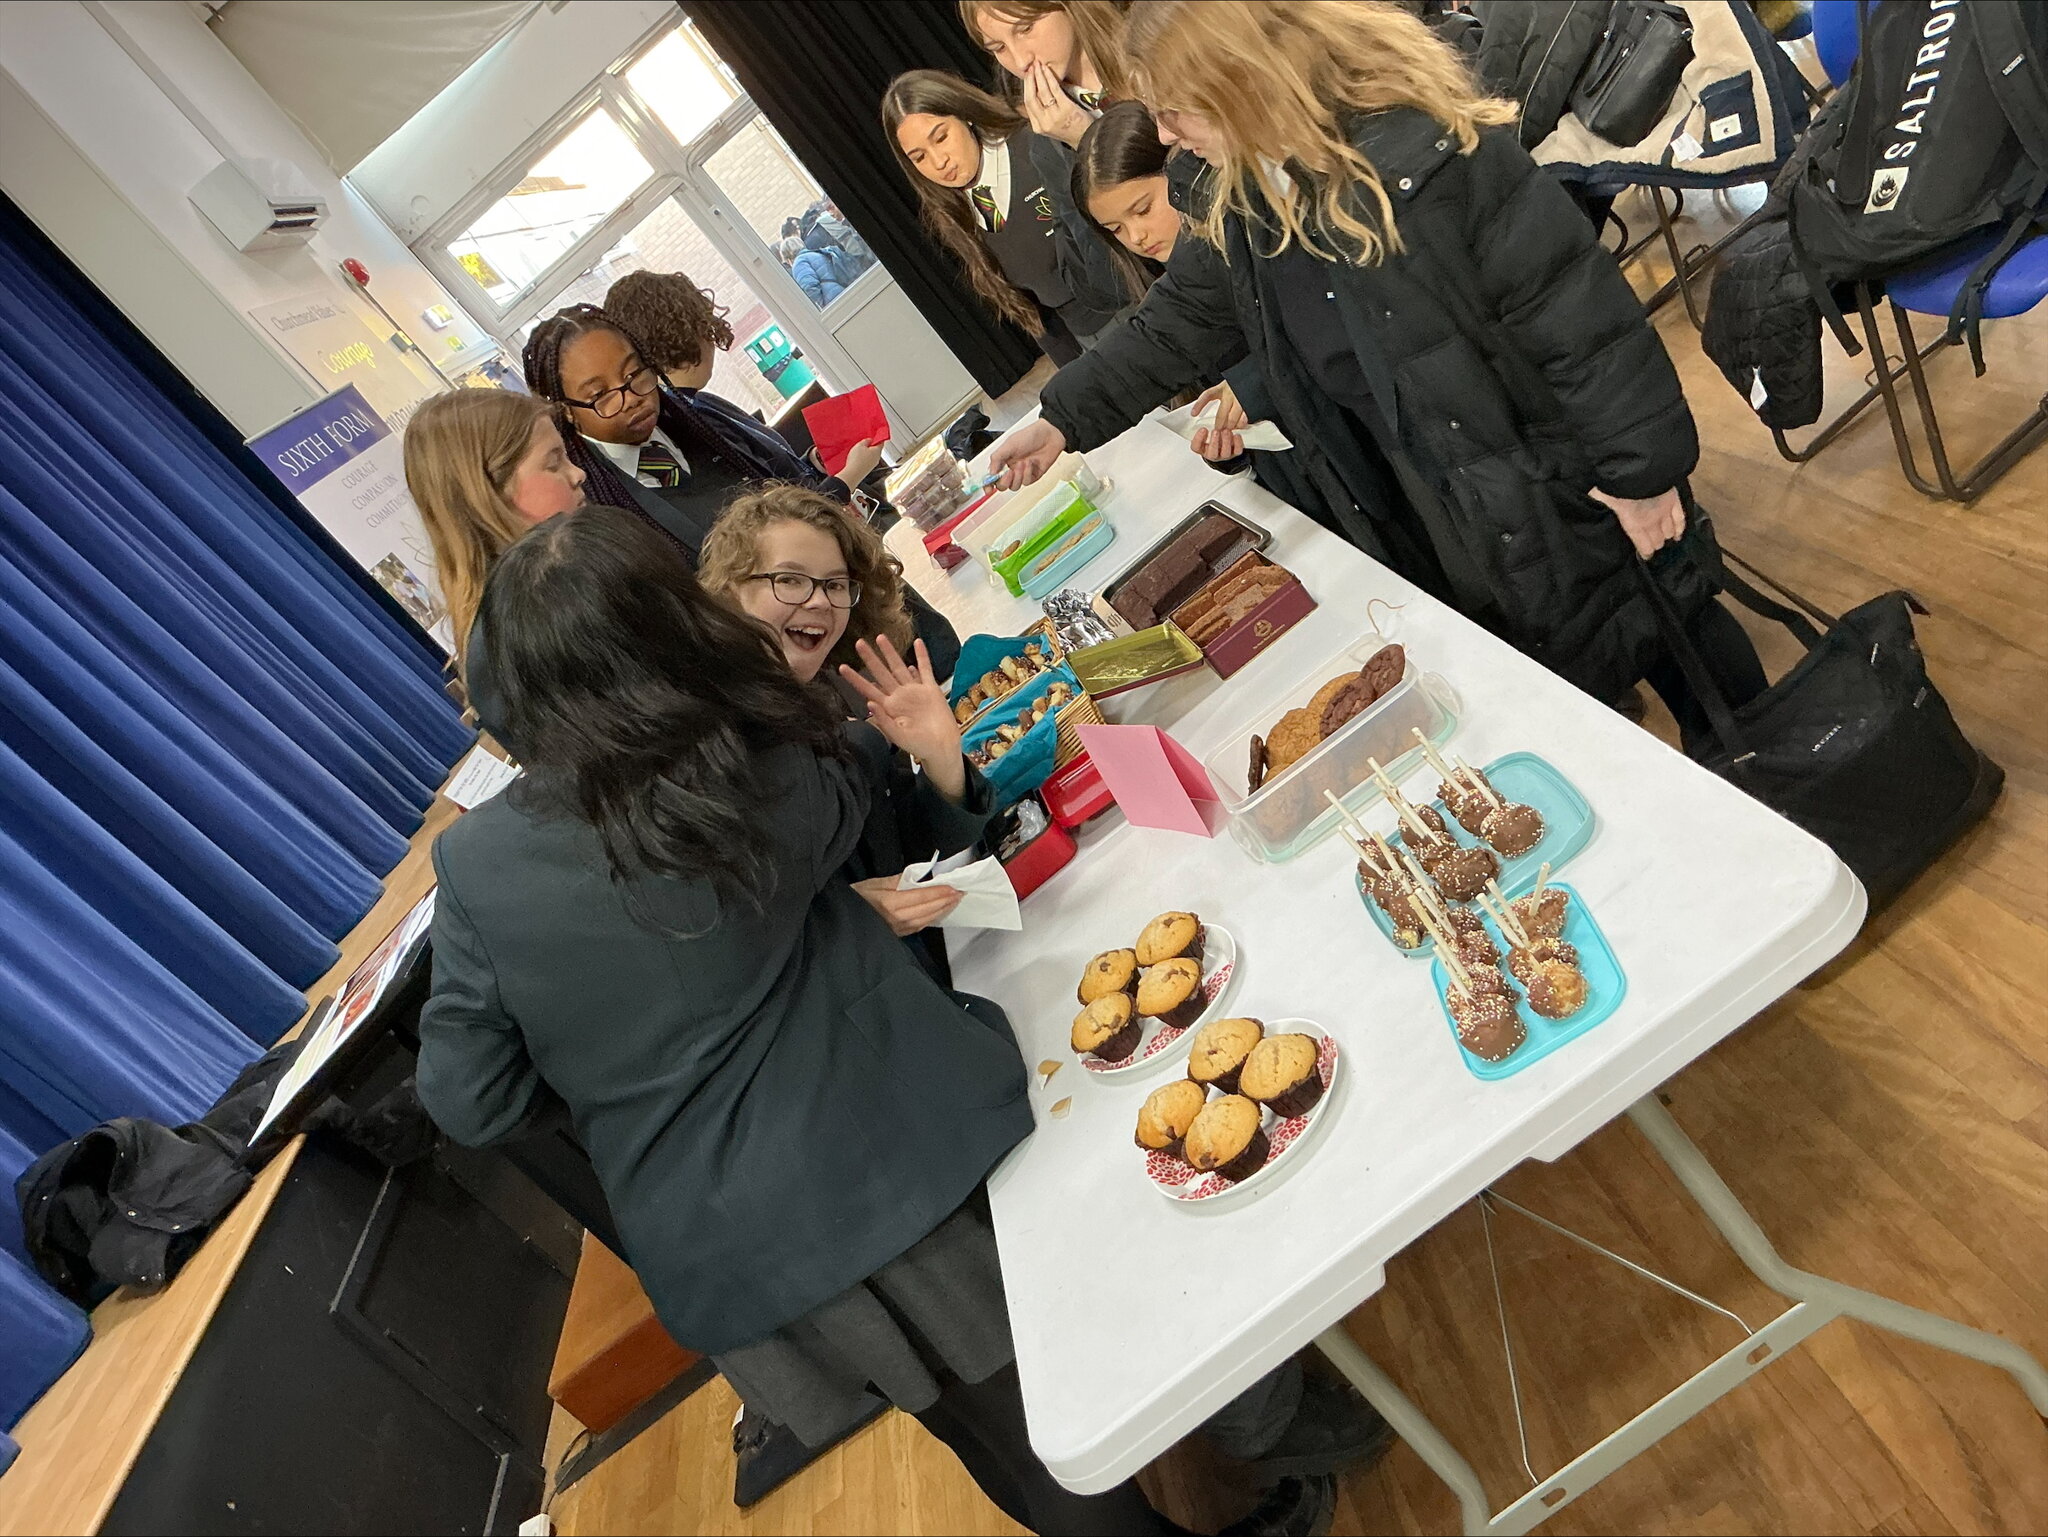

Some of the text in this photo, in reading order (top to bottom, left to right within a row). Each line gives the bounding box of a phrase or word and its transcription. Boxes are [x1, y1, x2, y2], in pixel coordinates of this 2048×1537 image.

[318, 341, 376, 373] Courage
[278, 433, 334, 477] SIXTH
[323, 408, 375, 448] FORM
[341, 461, 379, 488] COURAGE
